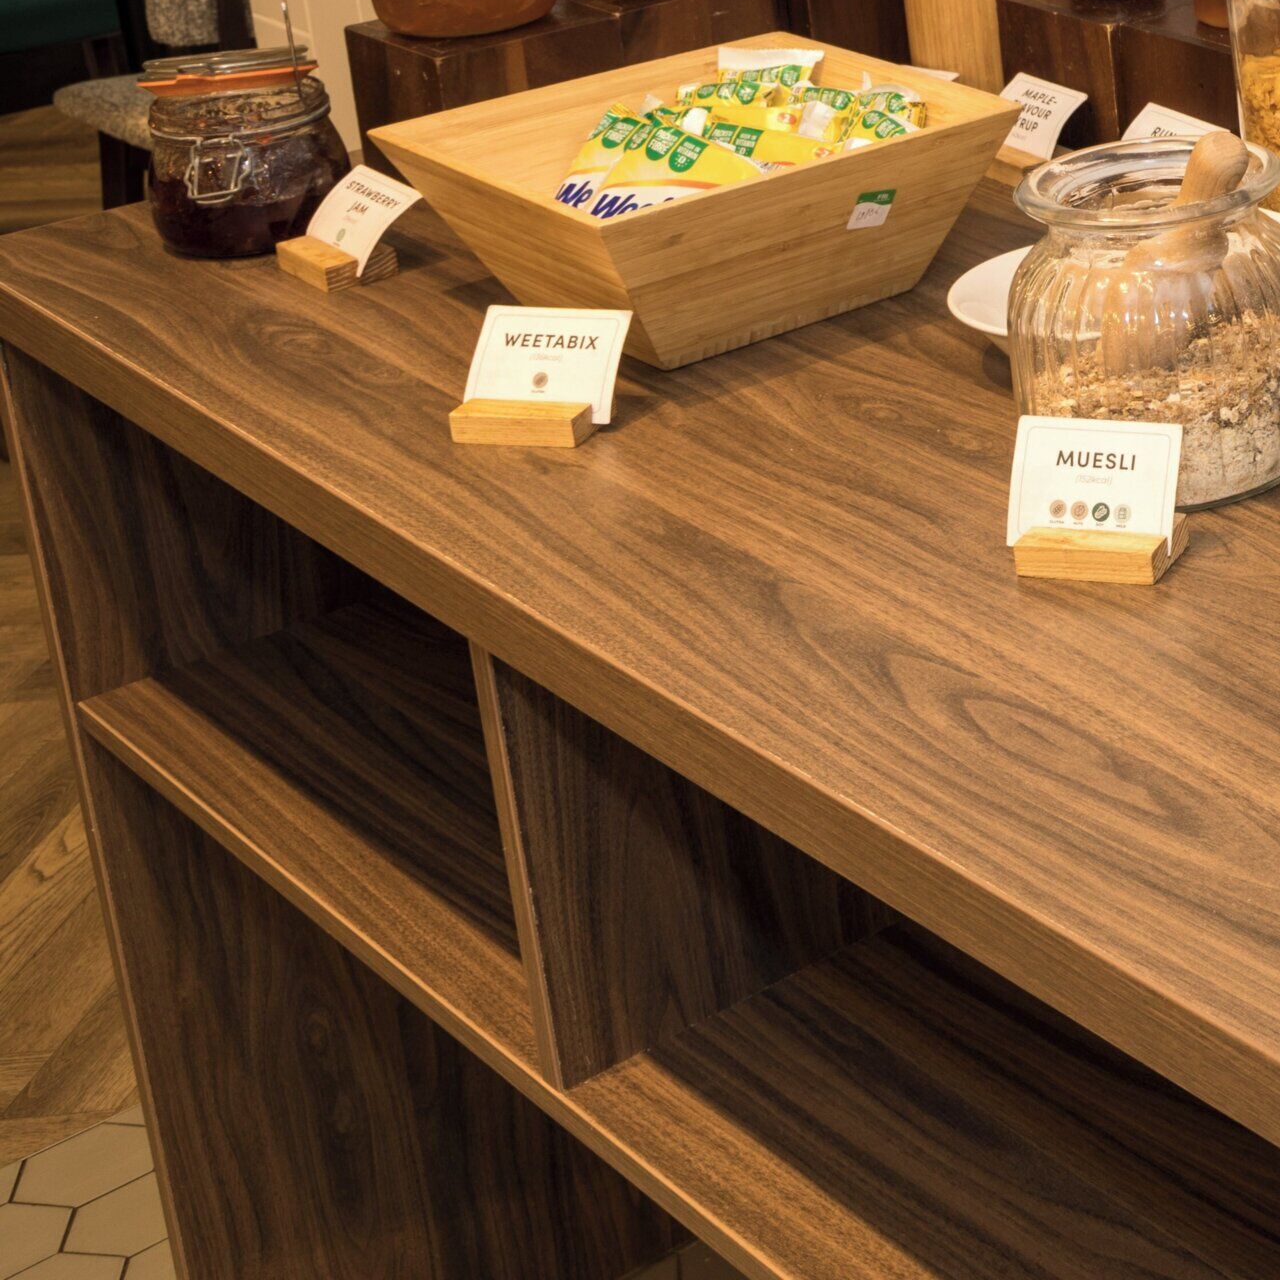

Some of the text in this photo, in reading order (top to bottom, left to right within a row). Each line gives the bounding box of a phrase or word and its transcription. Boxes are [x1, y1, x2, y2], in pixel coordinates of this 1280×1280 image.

[1022, 89, 1057, 105] MAPLE-
[346, 180, 401, 210] STRAWBERRY
[347, 201, 369, 215] JAM
[505, 333, 599, 350] WEETABIX
[1056, 450, 1136, 470] MUESLI
